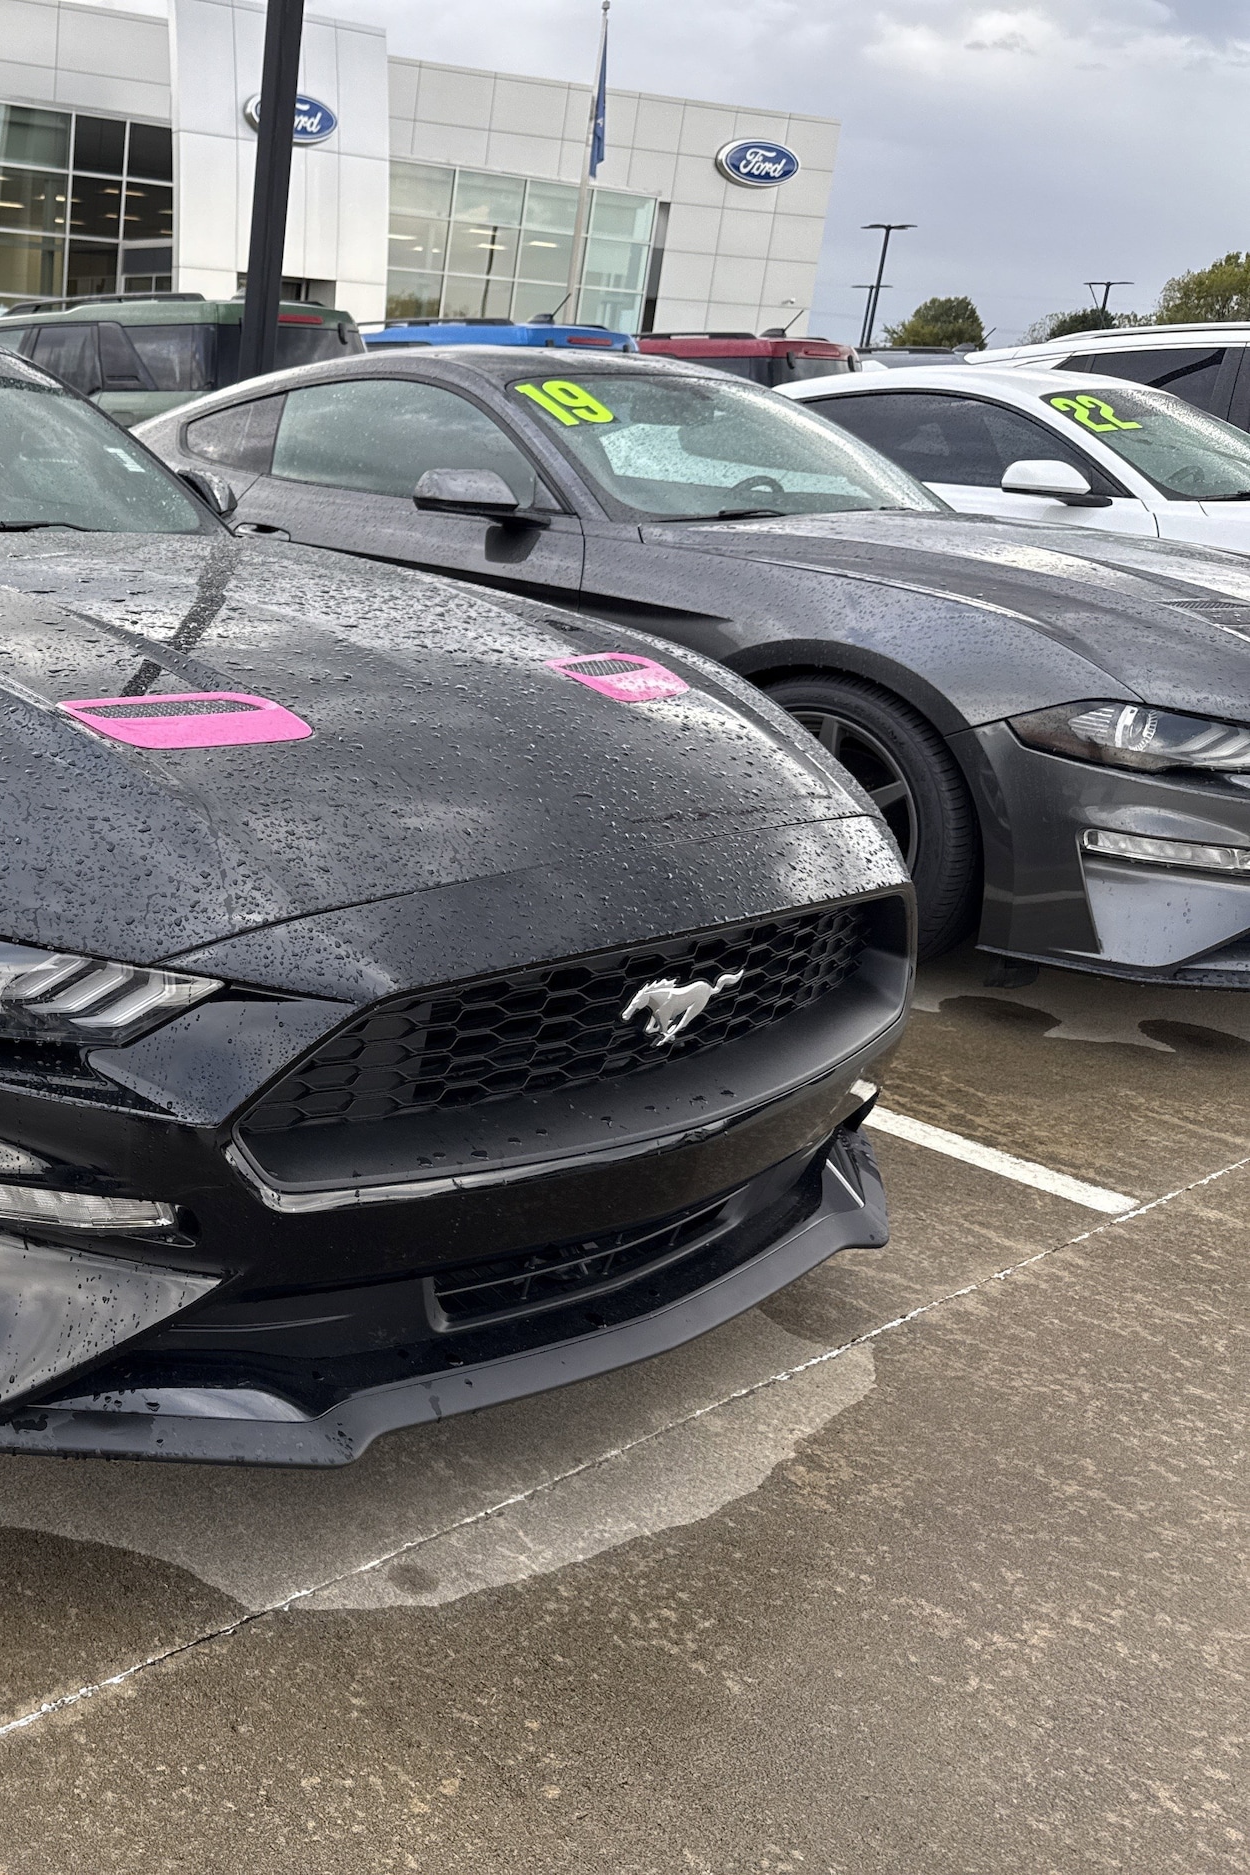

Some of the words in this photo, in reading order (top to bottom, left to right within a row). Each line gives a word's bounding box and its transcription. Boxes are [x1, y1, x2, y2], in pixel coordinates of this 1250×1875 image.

[739, 147, 787, 178] Ford
[514, 380, 614, 426] 19
[1050, 395, 1143, 432] 22
